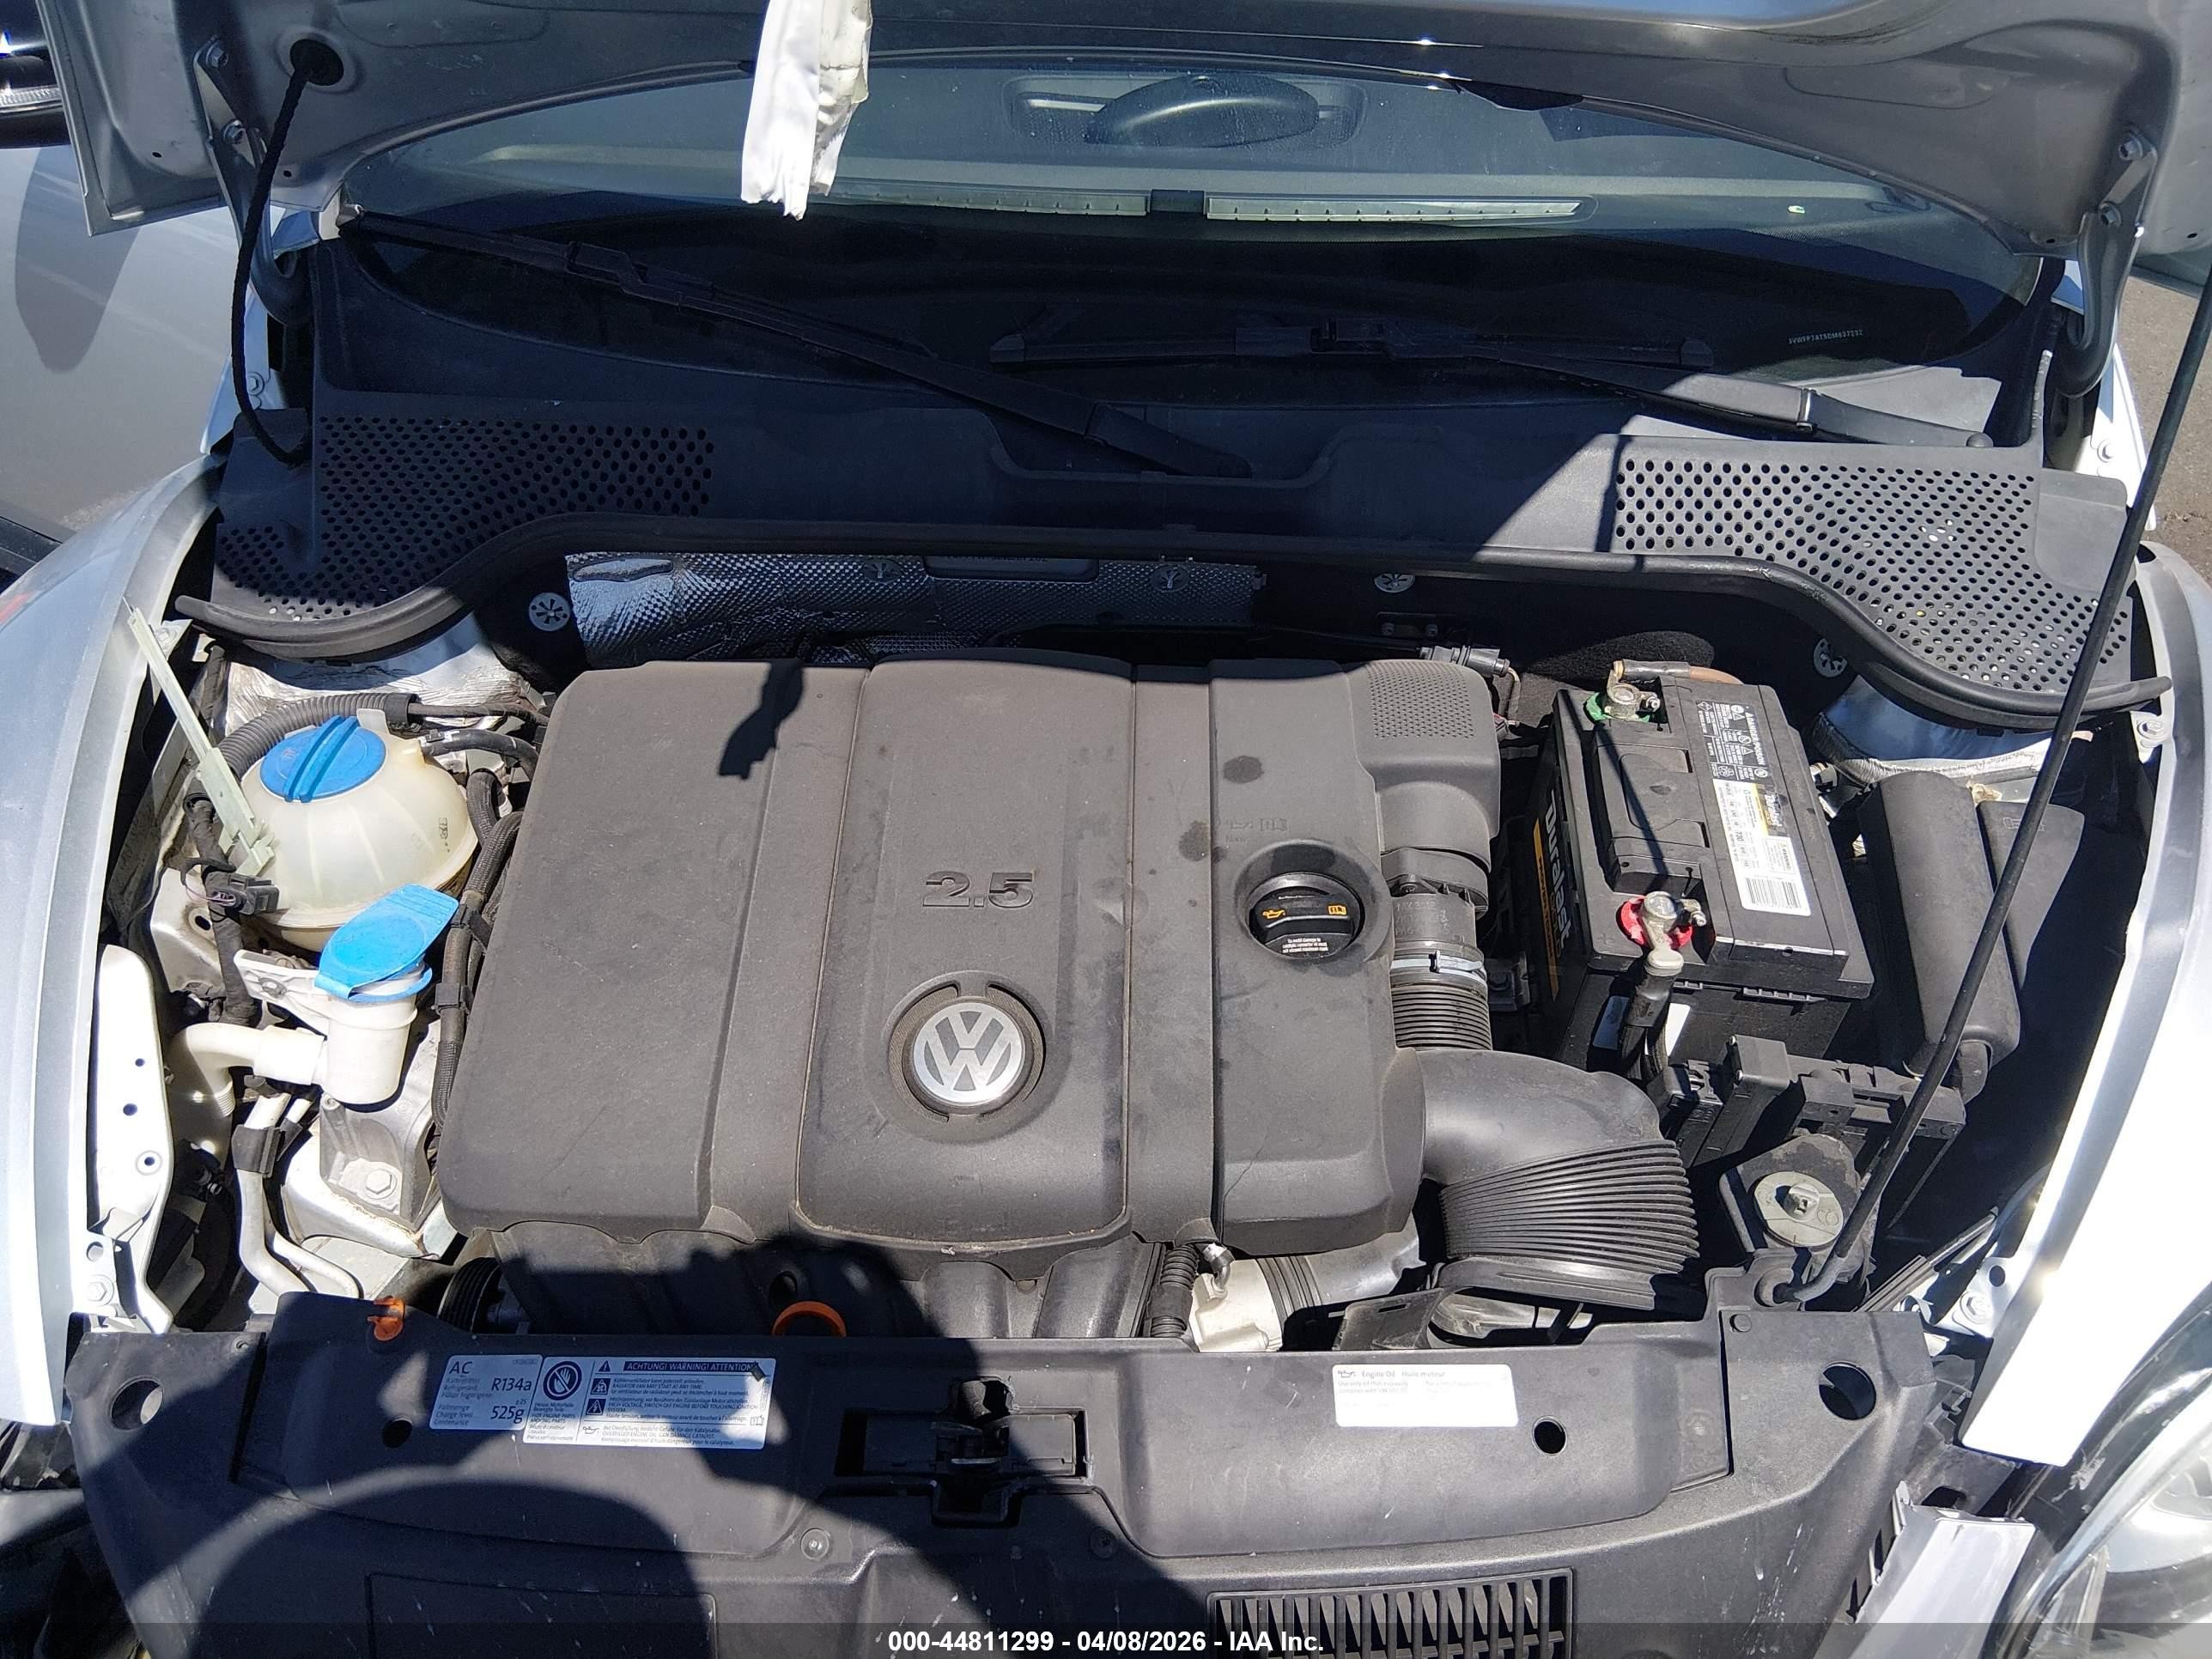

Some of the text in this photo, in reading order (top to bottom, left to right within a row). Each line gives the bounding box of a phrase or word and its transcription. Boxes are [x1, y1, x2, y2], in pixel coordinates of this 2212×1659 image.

[1546, 789, 1571, 949] Duralast
[923, 870, 1034, 908] 2.5
[917, 1006, 1020, 1098] VW
[449, 1361, 473, 1374] AC
[627, 1362, 667, 1370] ACHTUNG!
[670, 1362, 709, 1371] WARNING!
[1362, 1370, 1384, 1379] Engine
[491, 1378, 532, 1391] R134a
[490, 1406, 525, 1424] 525g
